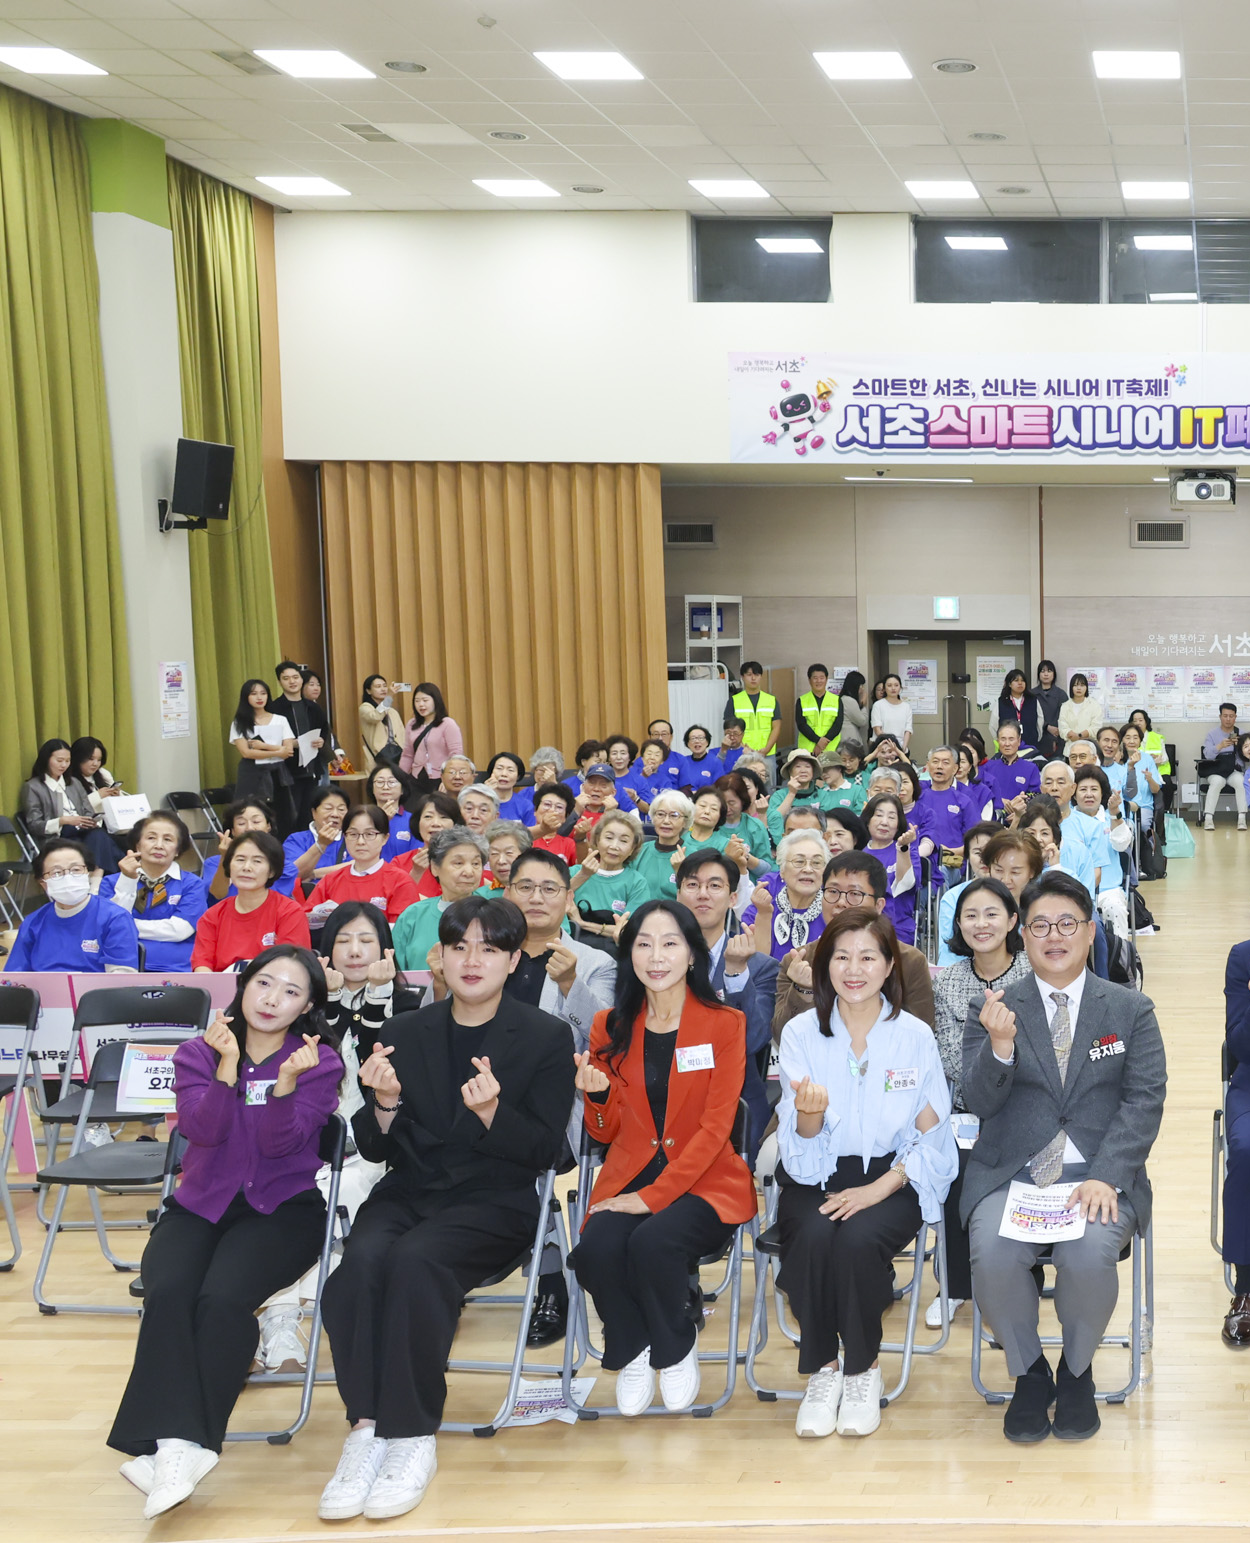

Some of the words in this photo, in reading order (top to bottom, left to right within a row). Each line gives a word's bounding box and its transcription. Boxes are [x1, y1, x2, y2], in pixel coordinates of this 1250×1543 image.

[775, 360, 801, 373] 서초
[852, 378, 928, 397] 스마트한
[933, 378, 977, 399] 서초,
[981, 378, 1037, 397] 신나는
[1043, 378, 1099, 397] 시니어
[1106, 378, 1169, 397] IT축제!
[1147, 634, 1166, 645] 오늘
[1169, 634, 1207, 645] 행복하고
[1131, 646, 1158, 656] 내일이
[1162, 646, 1207, 657] 기다려지는
[1089, 1040, 1126, 1062] 유지웅
[148, 1077, 175, 1090] 오지
[894, 1079, 916, 1088] 안종숙
